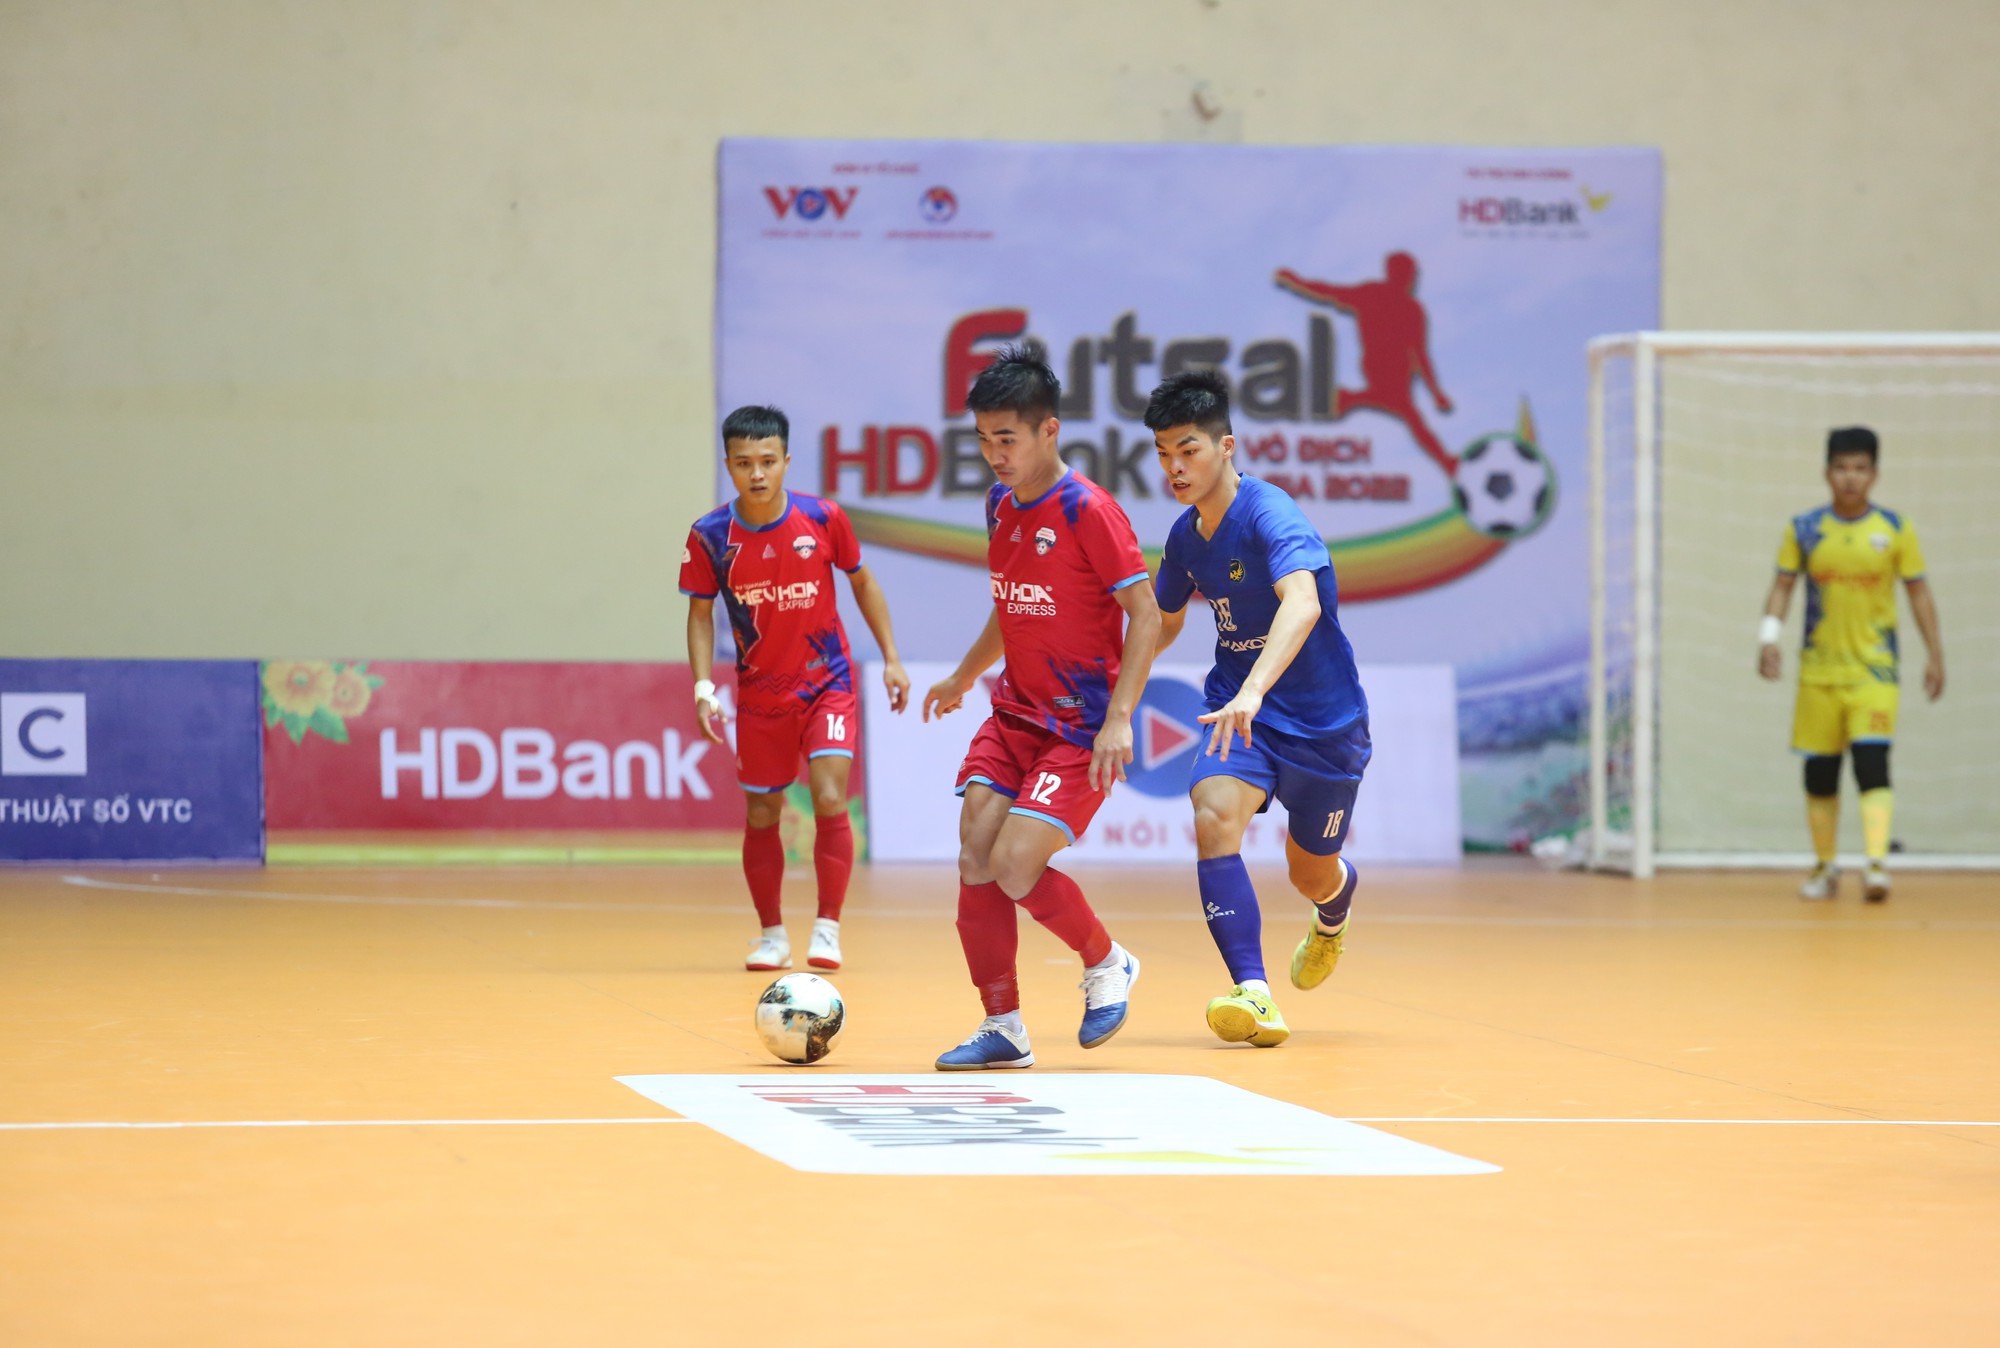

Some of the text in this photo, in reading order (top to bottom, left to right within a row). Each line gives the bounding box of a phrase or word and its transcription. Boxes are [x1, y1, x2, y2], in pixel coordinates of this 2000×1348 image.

[763, 186, 859, 221] VOV
[1457, 197, 1580, 225] HDBank
[819, 424, 1151, 500] HDBnk
[1007, 602, 1056, 616] EXPRESS
[18, 708, 65, 760] C
[826, 713, 846, 742] 16
[379, 728, 713, 800] HDBank
[1030, 771, 1062, 806] 12
[0, 792, 193, 827] THUẬT SỐ VTC
[1322, 809, 1345, 838] 18
